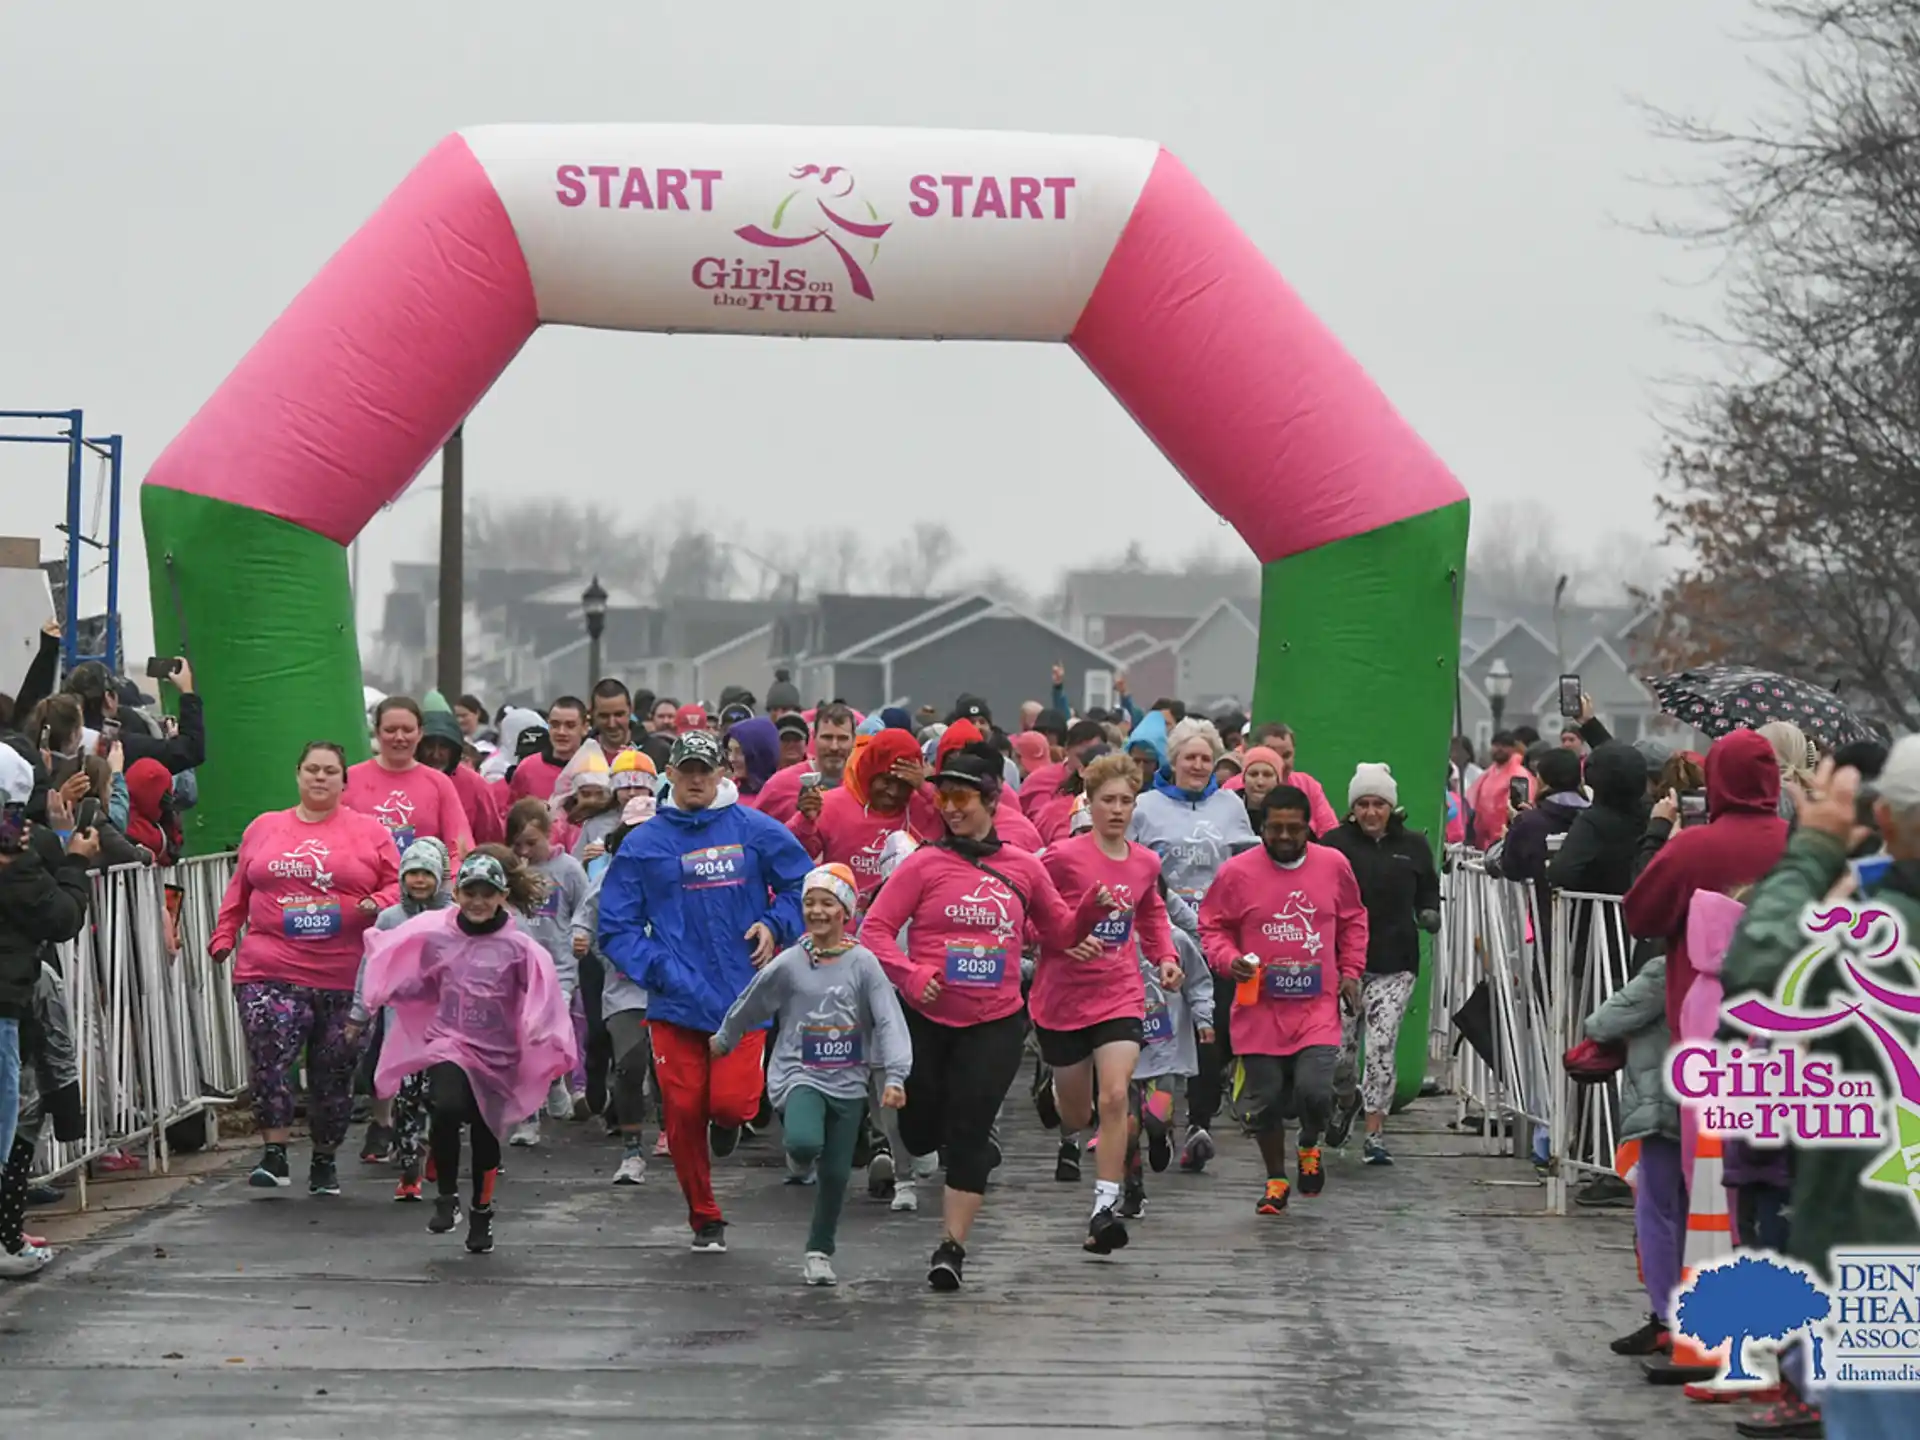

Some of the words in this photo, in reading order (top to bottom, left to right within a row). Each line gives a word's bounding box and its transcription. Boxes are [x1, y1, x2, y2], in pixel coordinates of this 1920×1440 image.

[556, 164, 723, 211] START
[909, 174, 1076, 219] START
[692, 256, 807, 291] Girls
[808, 281, 834, 292] on
[713, 293, 748, 306] the
[748, 293, 837, 313] run
[268, 859, 304, 873] Girls
[695, 859, 735, 876] 2044
[944, 904, 987, 918] Girls
[294, 914, 331, 929] 2032
[1262, 922, 1294, 935] Girls
[958, 958, 997, 974] 2030
[1275, 975, 1312, 989] 2040
[814, 1040, 853, 1056] 1020
